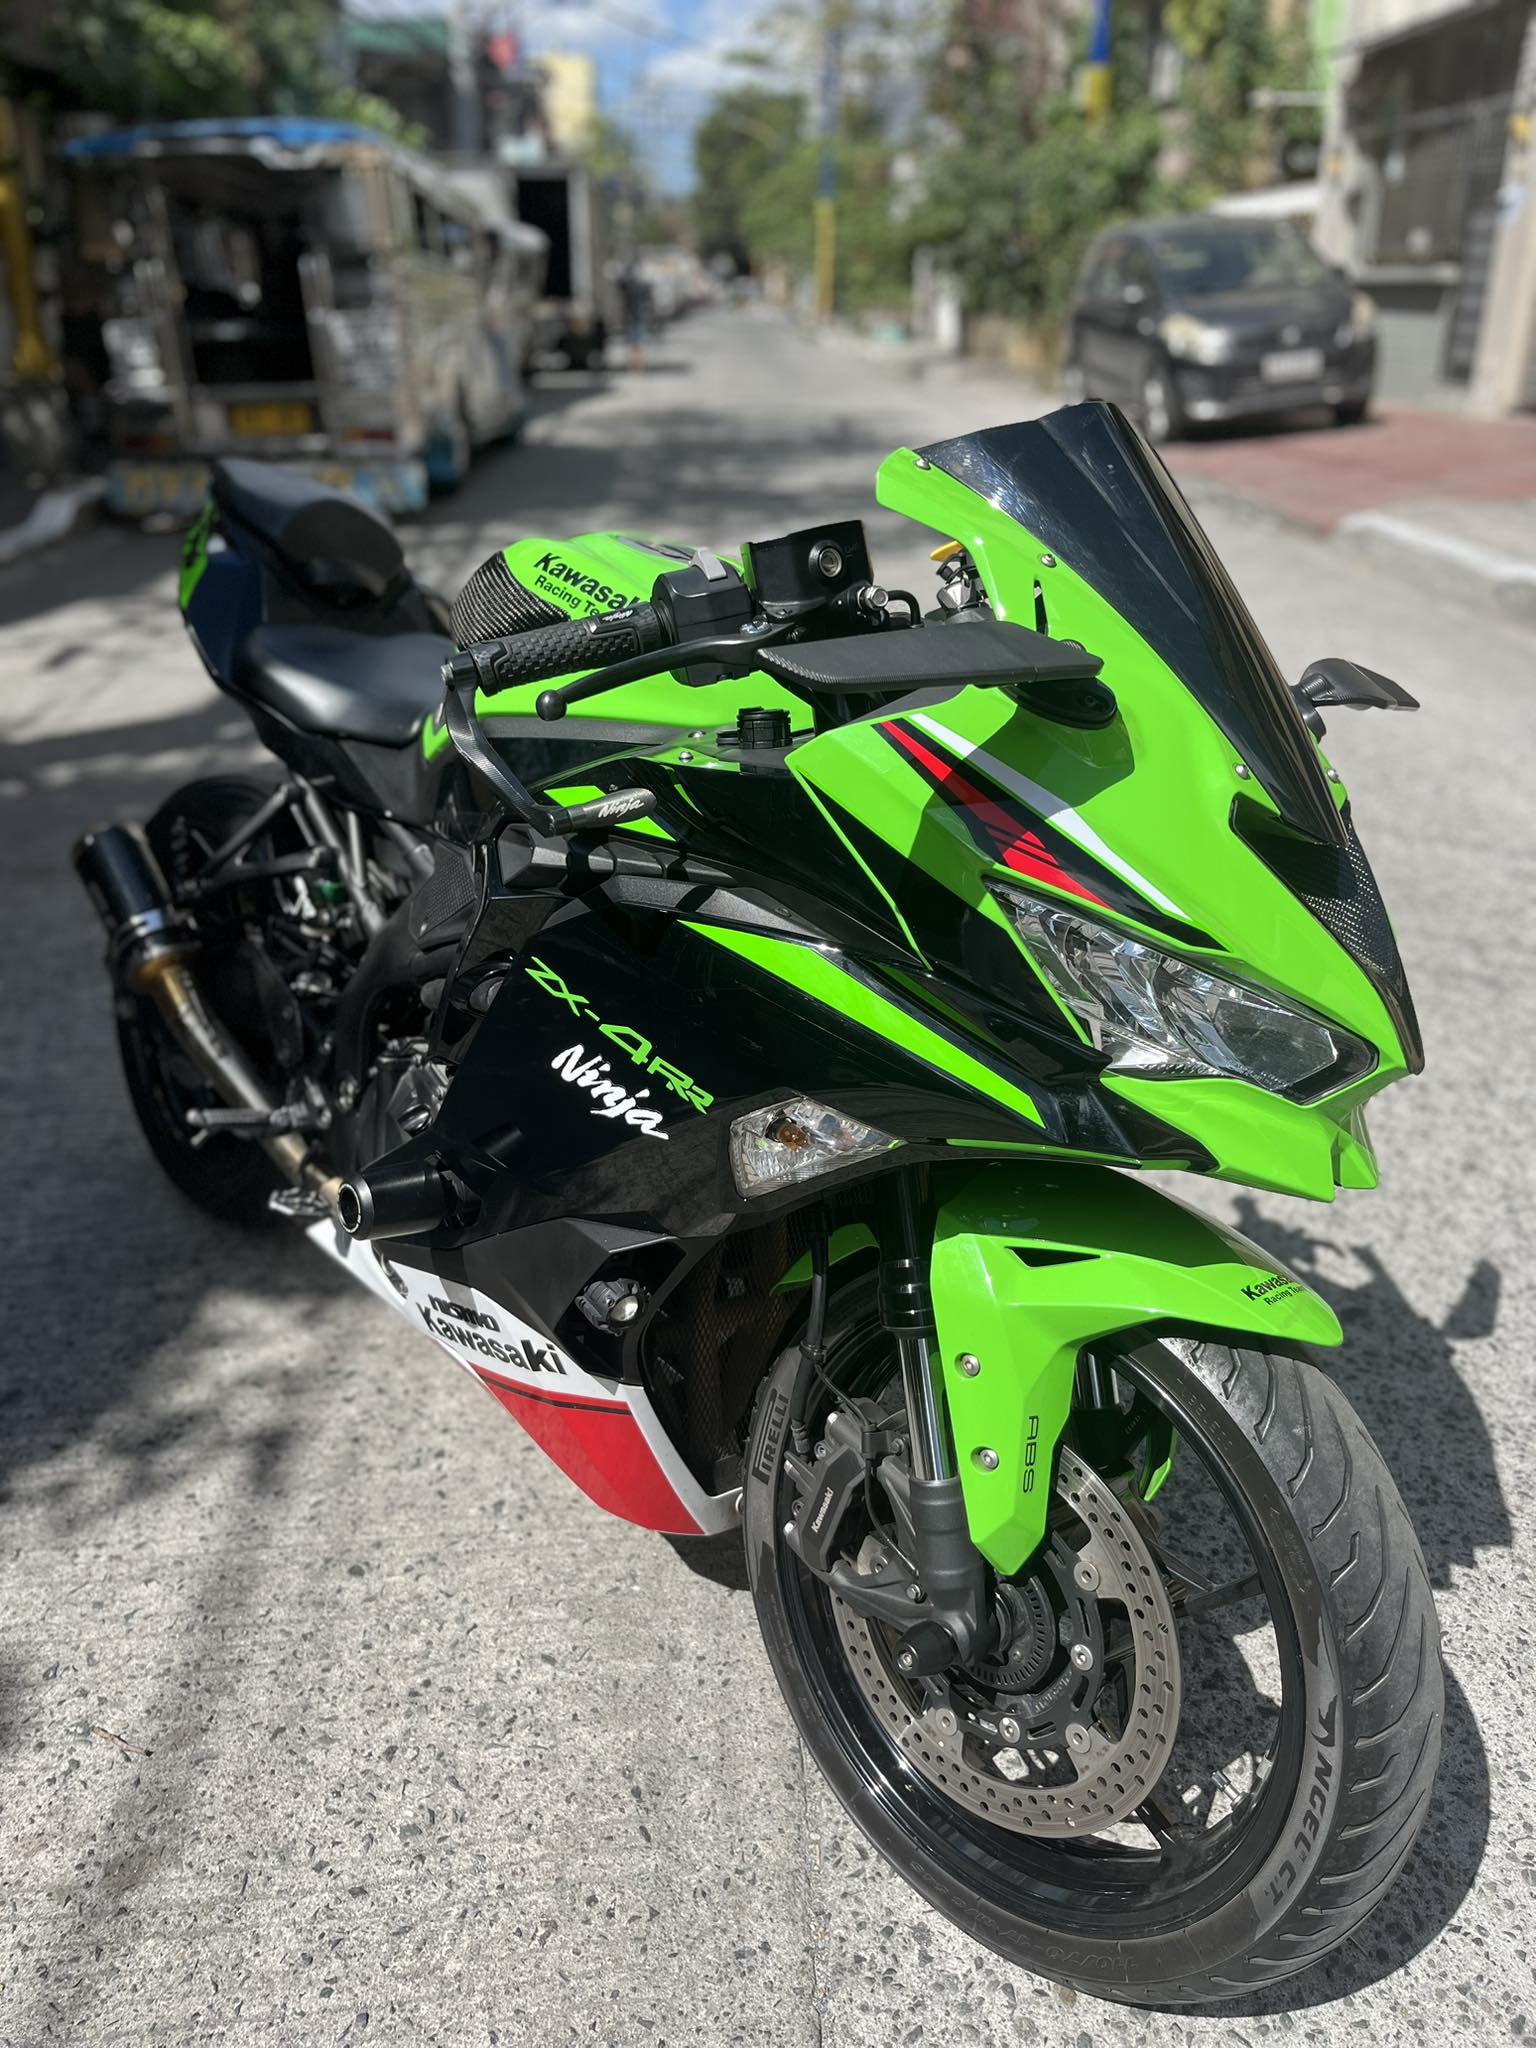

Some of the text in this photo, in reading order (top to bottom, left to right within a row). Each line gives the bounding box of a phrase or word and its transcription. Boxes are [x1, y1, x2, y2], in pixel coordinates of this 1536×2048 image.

[533, 552, 641, 610] Kawasa
[534, 574, 600, 617] Racing Te
[597, 797, 645, 818] Ninja
[550, 1043, 670, 1141] Ninja
[415, 1301, 567, 1376] Kawasaki
[751, 1387, 790, 1486] PIRELLI
[1022, 1415, 1040, 1494] ABS
[810, 1486, 835, 1533] Kawasaki
[1268, 1859, 1297, 1906] CT
